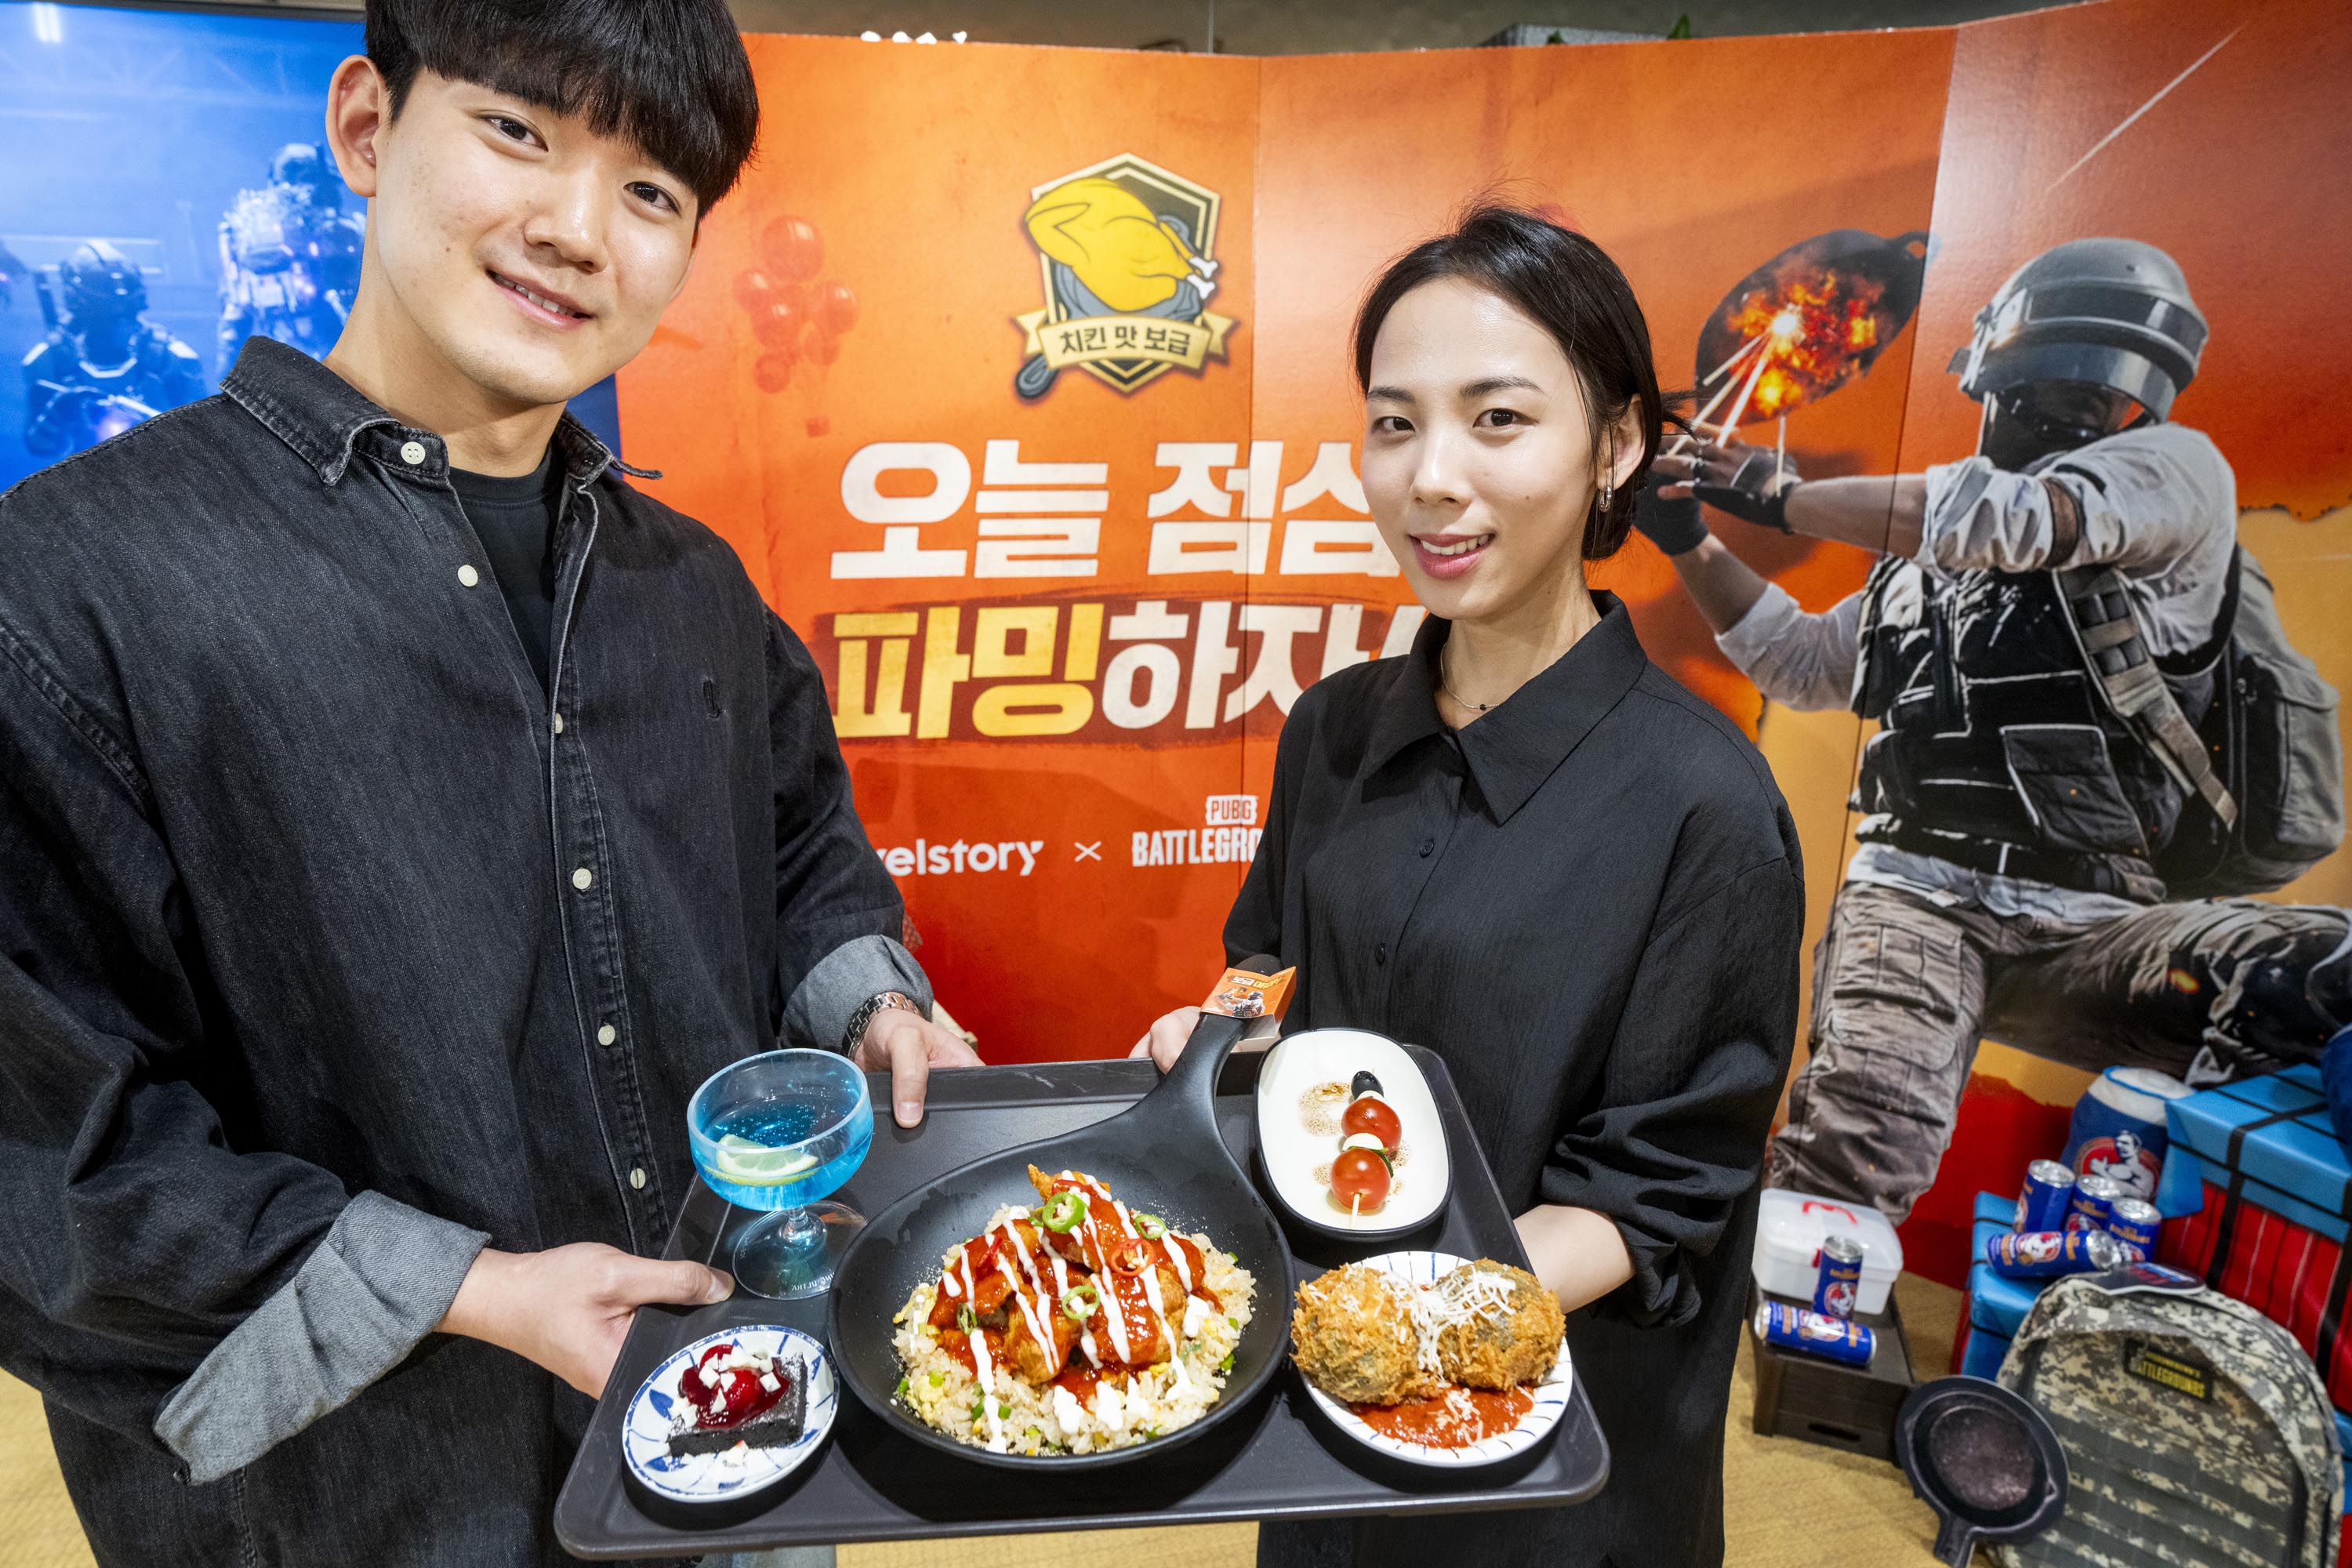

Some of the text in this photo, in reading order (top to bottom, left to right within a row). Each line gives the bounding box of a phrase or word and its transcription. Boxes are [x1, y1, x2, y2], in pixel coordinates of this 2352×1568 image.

[1060, 326, 1191, 356] 치킨 맛 보급
[830, 439, 1109, 579] 오늘
[1210, 799, 1252, 821] PUBG
